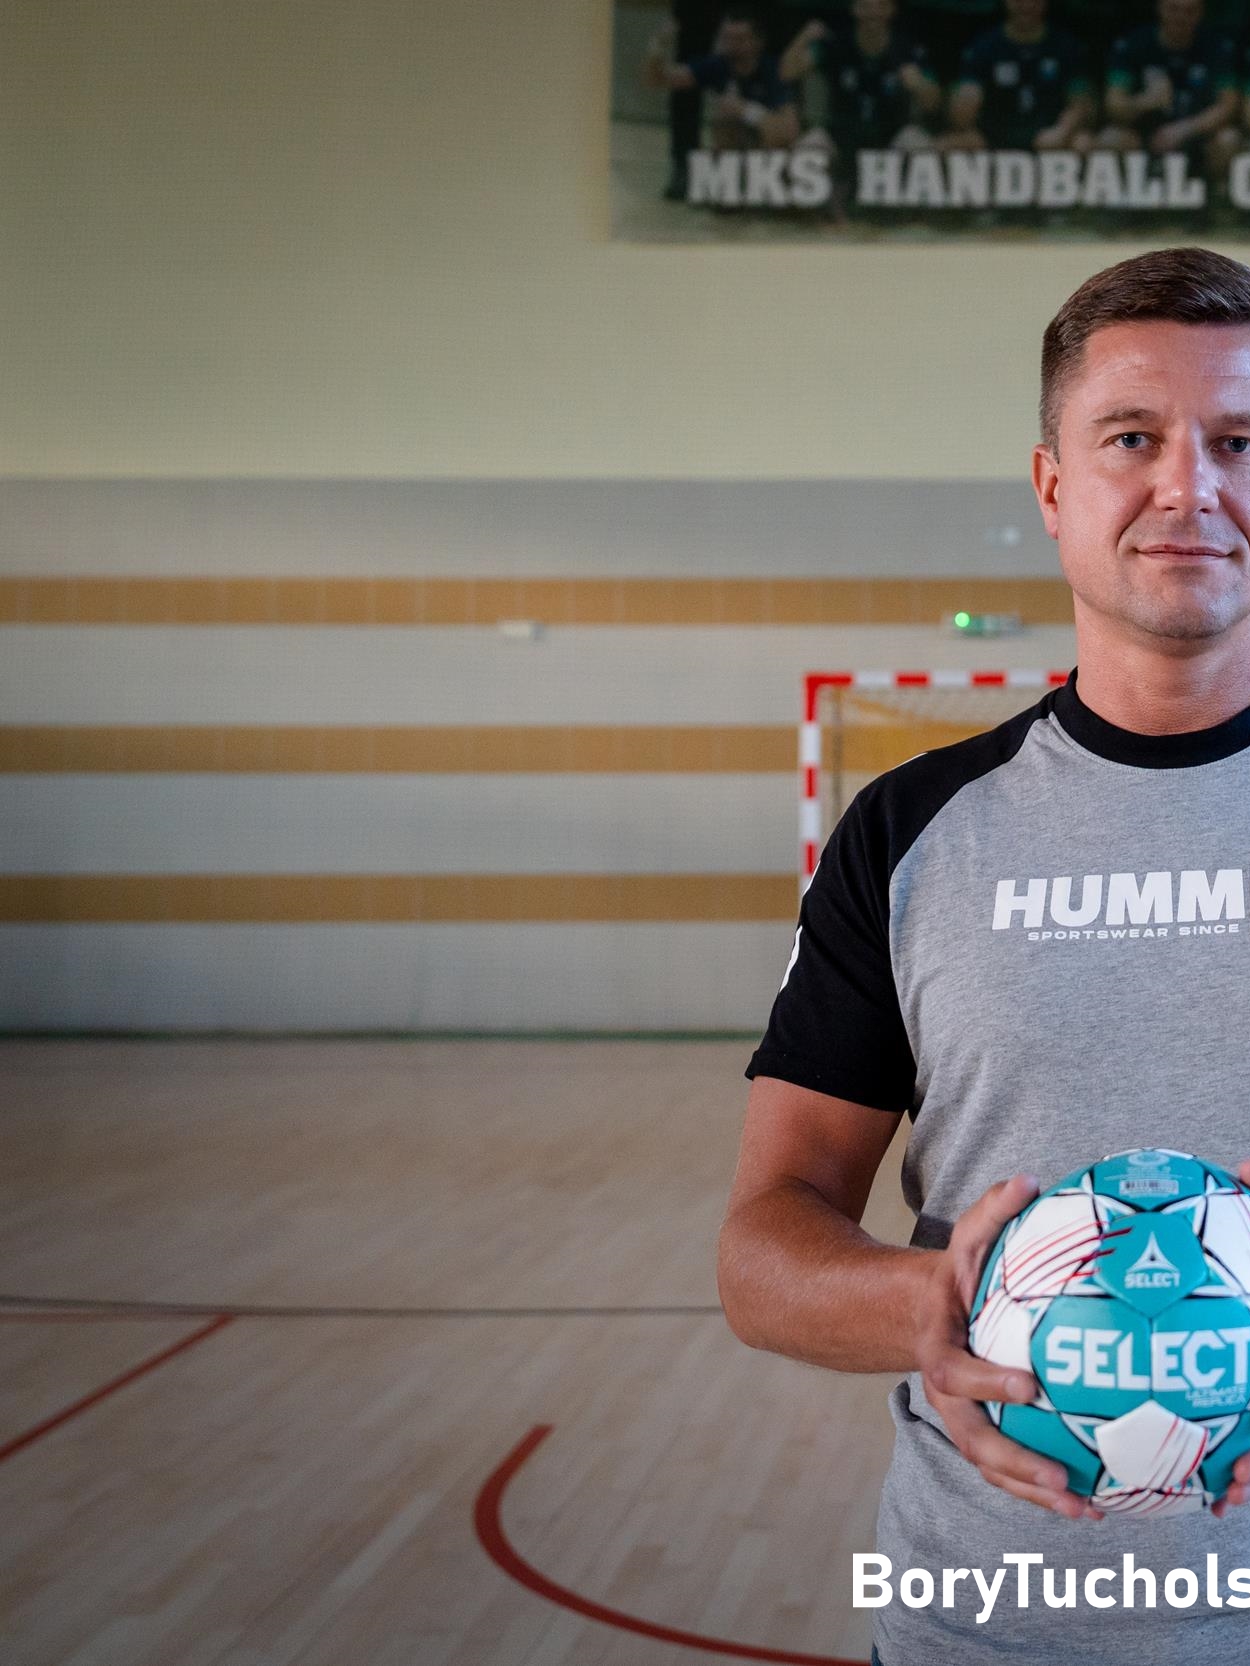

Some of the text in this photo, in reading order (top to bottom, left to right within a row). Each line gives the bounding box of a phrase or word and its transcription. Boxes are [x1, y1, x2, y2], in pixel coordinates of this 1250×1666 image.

[687, 150, 832, 207] MKS
[857, 150, 1206, 209] HANDBALL
[1027, 928, 1169, 941] SPORTSWEAR
[1178, 923, 1239, 935] SINCE
[1125, 1272, 1180, 1288] SELECT
